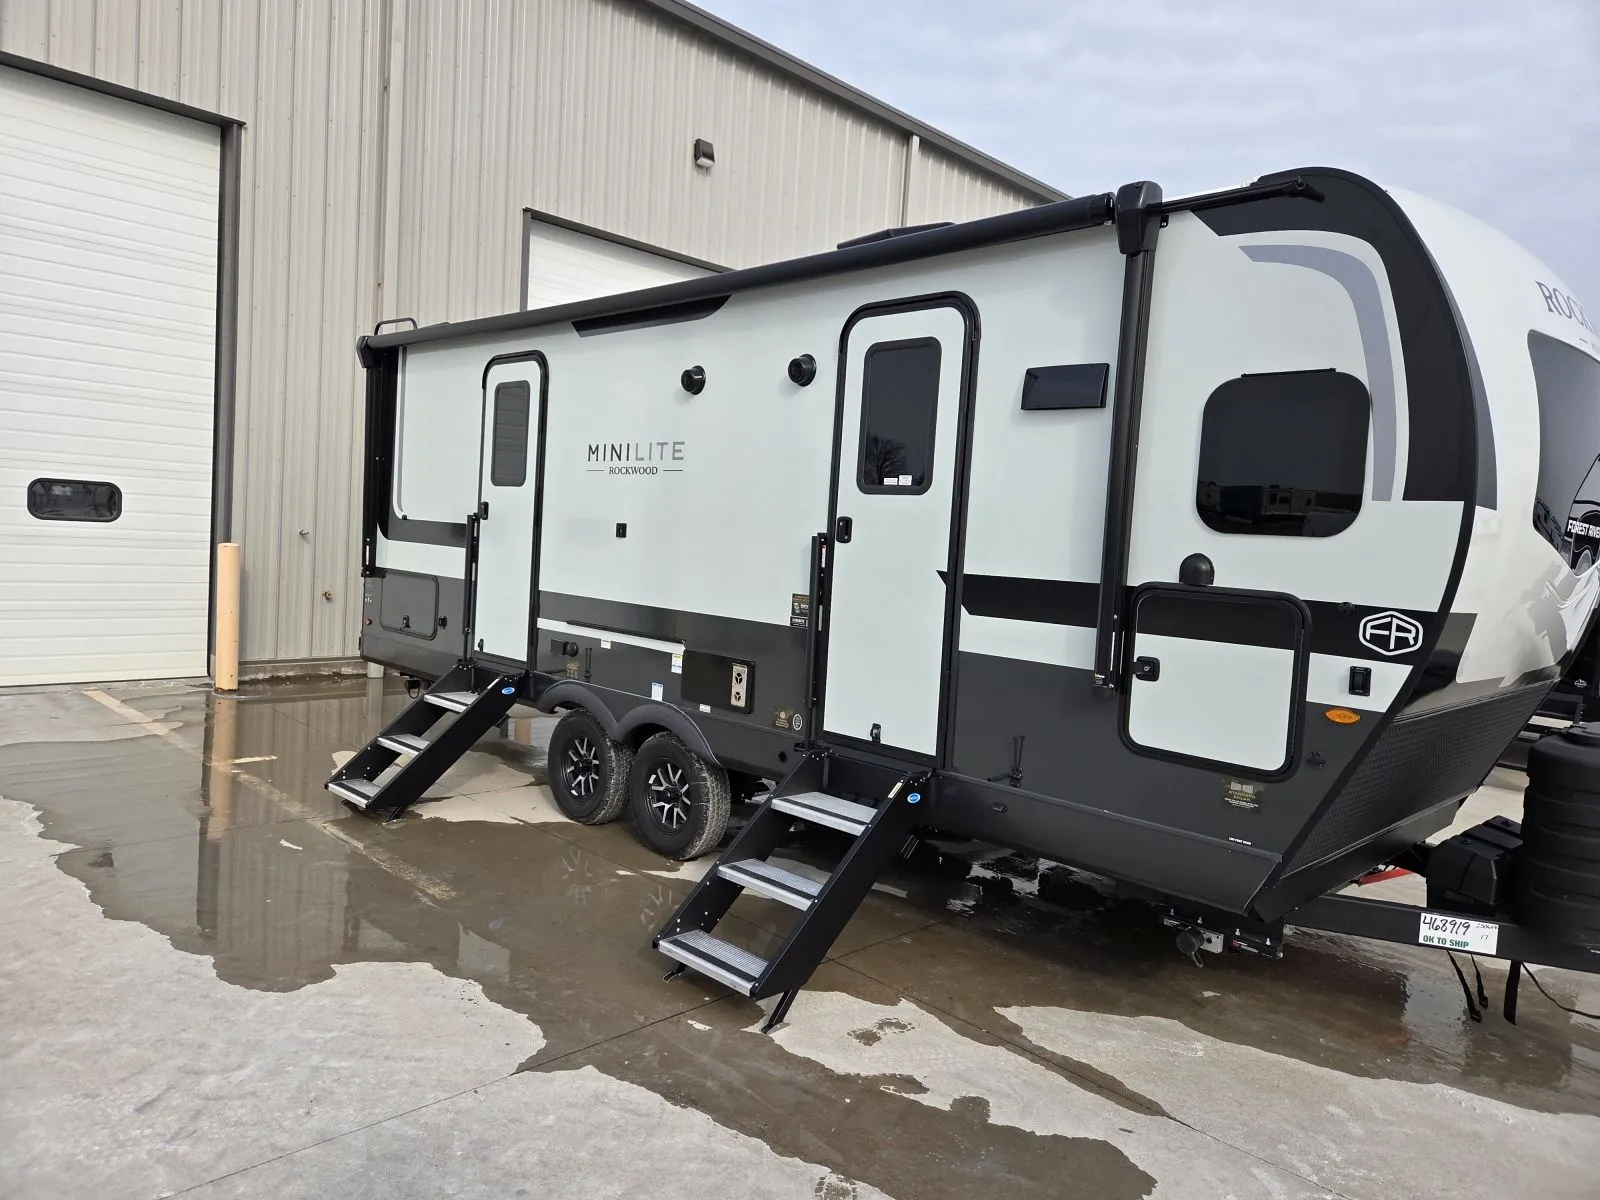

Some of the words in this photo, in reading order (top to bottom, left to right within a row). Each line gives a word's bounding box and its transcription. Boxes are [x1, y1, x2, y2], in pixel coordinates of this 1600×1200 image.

[608, 466, 658, 475] ROCKWOOD
[1567, 519, 1589, 536] FOREST
[1588, 524, 1600, 539] RIVE
[1364, 615, 1418, 651] FR
[1422, 915, 1471, 936] 468919
[1423, 934, 1435, 943] OK
[1437, 936, 1447, 945] TO
[1449, 939, 1470, 948] SHIP
